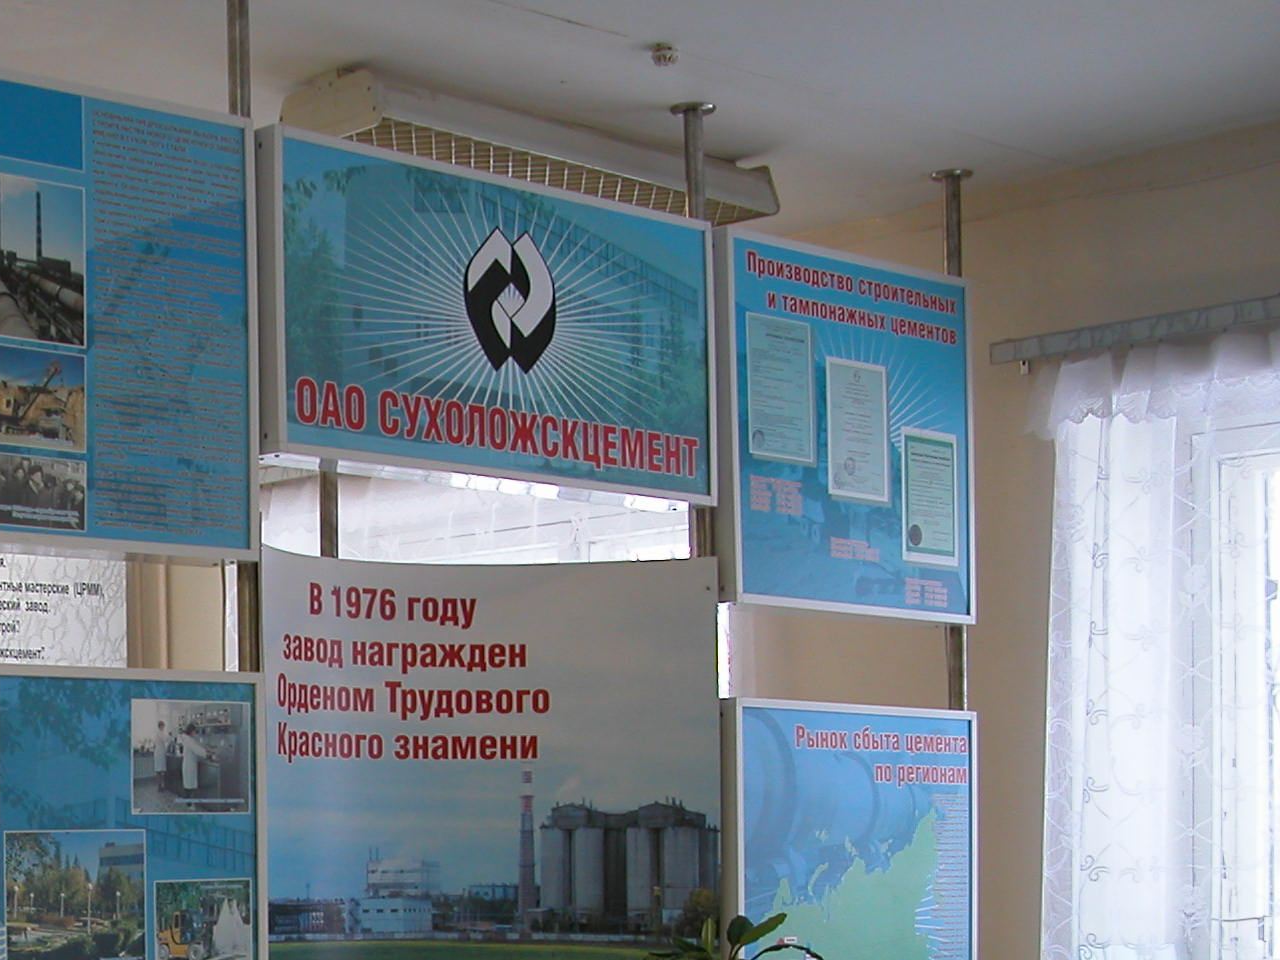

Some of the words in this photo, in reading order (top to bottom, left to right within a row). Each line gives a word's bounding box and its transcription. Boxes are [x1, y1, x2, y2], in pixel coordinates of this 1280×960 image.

[747, 251, 853, 292] Производство
[859, 281, 956, 314] строительных
[782, 295, 886, 330] тампонажных
[891, 317, 957, 344] цементов
[294, 376, 367, 432] ОАО
[378, 389, 700, 478] СУХОЛОЖСКЦЕМЕНТ
[24, 583, 70, 596] мастерские
[25, 602, 51, 614] завод.
[309, 582, 323, 616] В
[331, 584, 396, 621] 1976
[407, 596, 477, 629] году
[282, 633, 343, 669] завод
[351, 640, 527, 674] награжден
[277, 673, 375, 715] Орденом
[384, 681, 550, 721] Трудового
[277, 722, 383, 763] Красного
[394, 734, 538, 760] знамени
[794, 725, 848, 750] Рынок
[853, 726, 900, 752] сбыта
[905, 734, 968, 755] цемента
[874, 764, 892, 783] по
[897, 764, 968, 787] регионам
